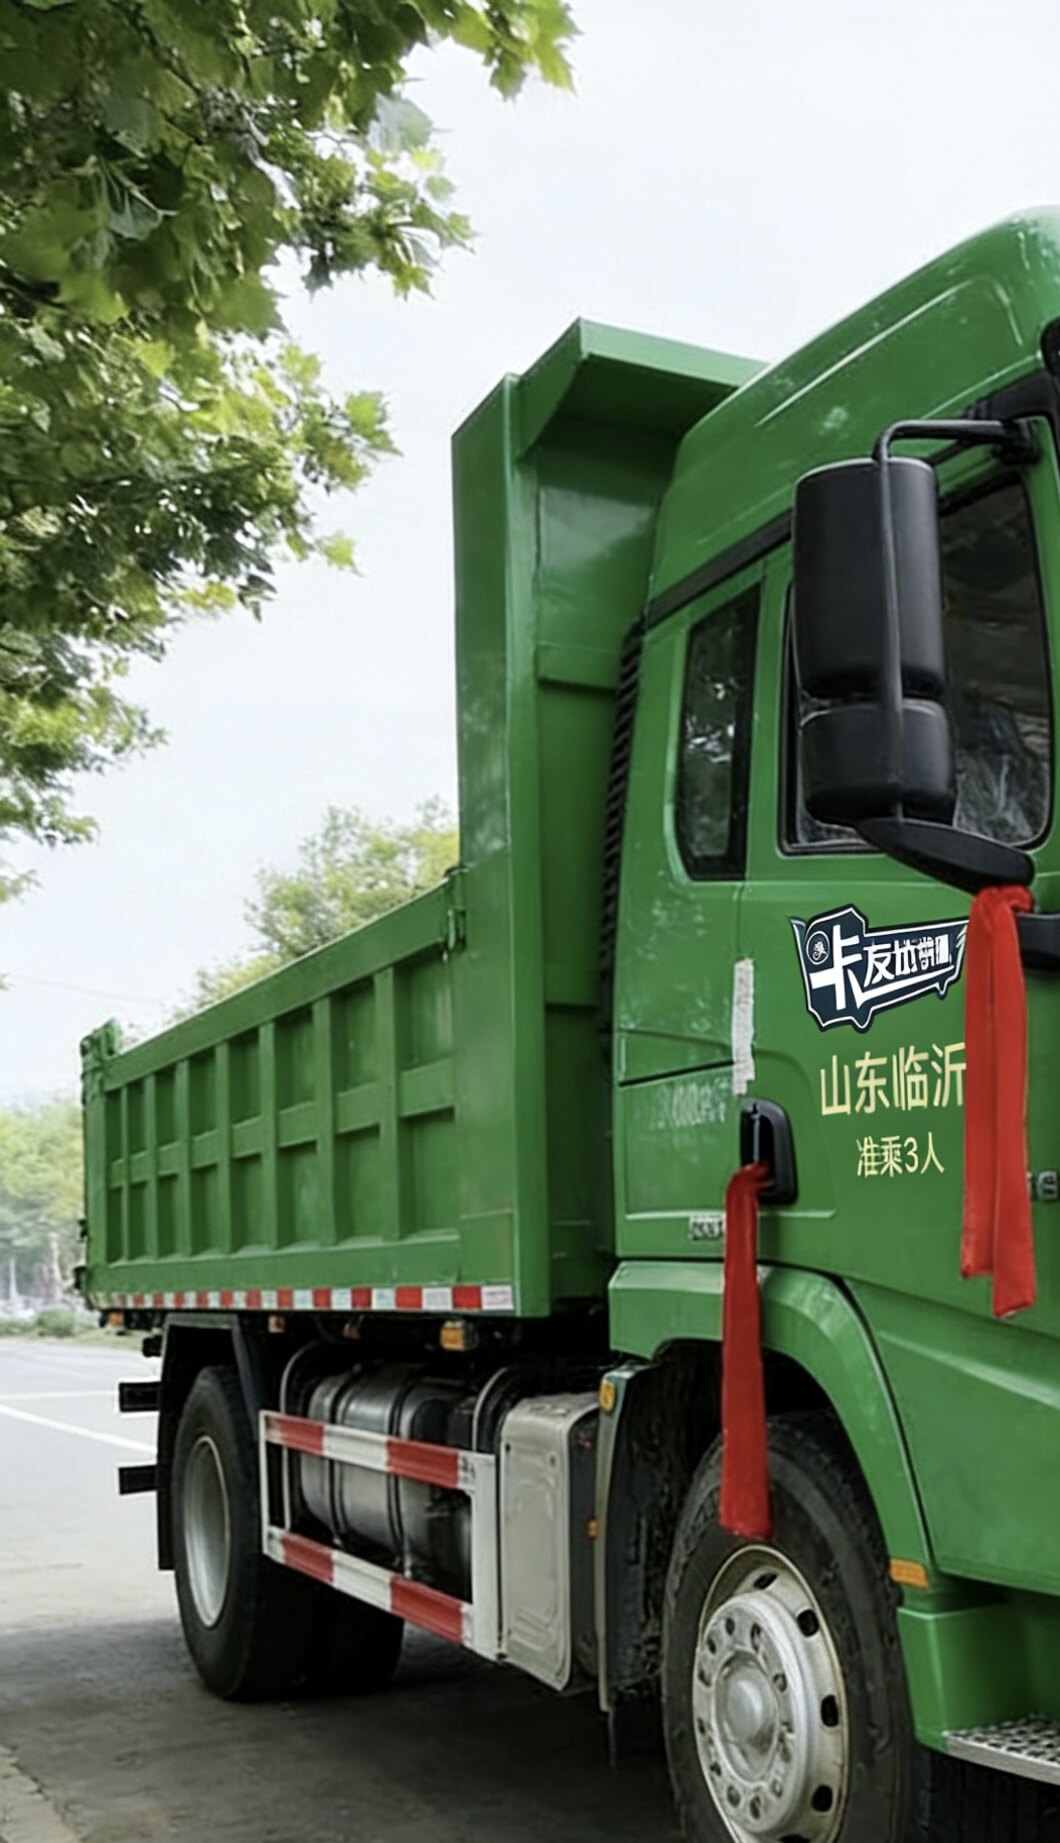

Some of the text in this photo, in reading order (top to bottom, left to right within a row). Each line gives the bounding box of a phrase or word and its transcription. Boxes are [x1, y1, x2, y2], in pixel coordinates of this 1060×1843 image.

[819, 1042, 966, 1116] 山东临沂
[856, 1131, 945, 1177] 准乘3人
